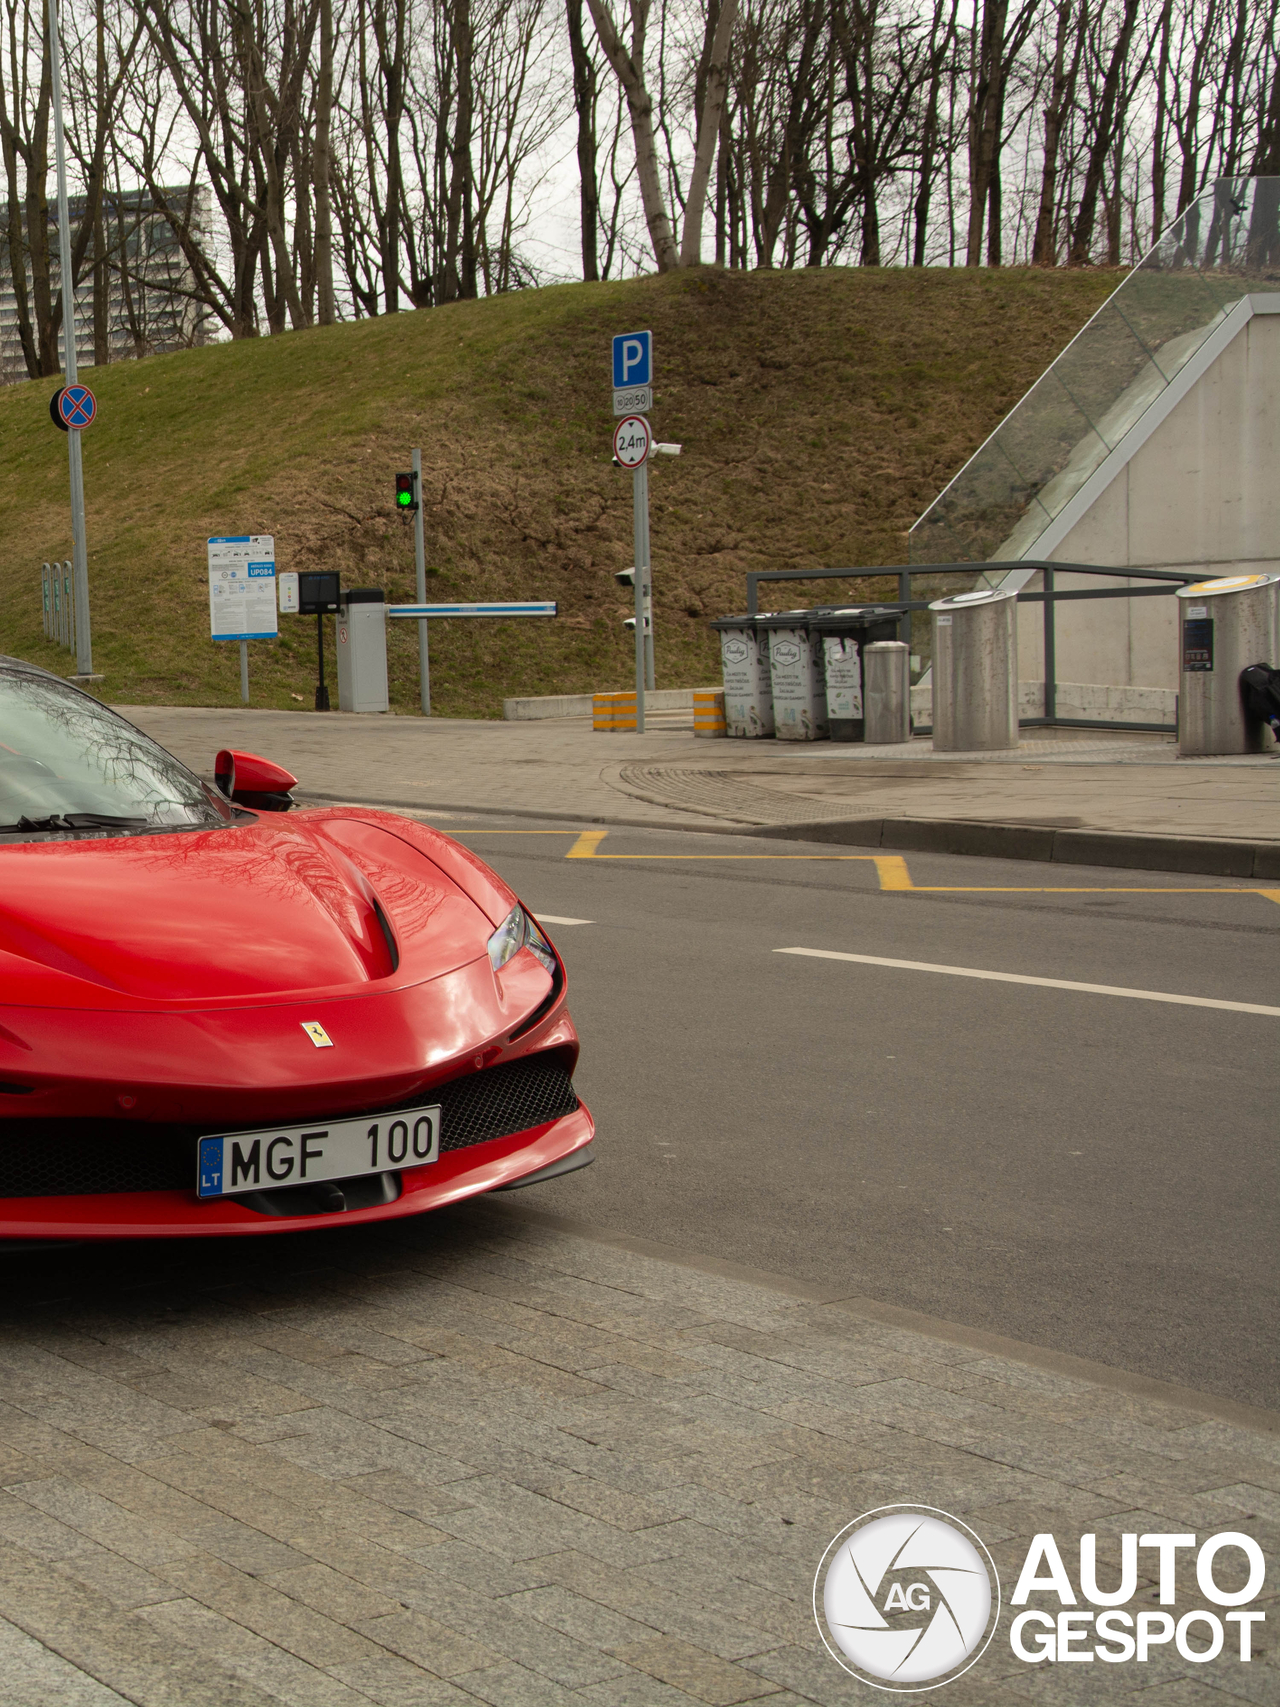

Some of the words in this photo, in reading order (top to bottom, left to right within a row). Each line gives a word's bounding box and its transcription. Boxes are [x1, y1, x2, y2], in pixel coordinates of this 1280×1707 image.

[622, 339, 643, 382] P
[617, 399, 623, 407] 10
[625, 396, 634, 406] 20
[635, 394, 646, 406] 50
[618, 434, 646, 452] 2,4m
[250, 568, 273, 576] UP084
[726, 646, 745, 657] Paulig
[775, 647, 797, 659] Paulig
[202, 1173, 219, 1188] LT
[231, 1130, 329, 1187] MGF
[367, 1115, 433, 1168] 100
